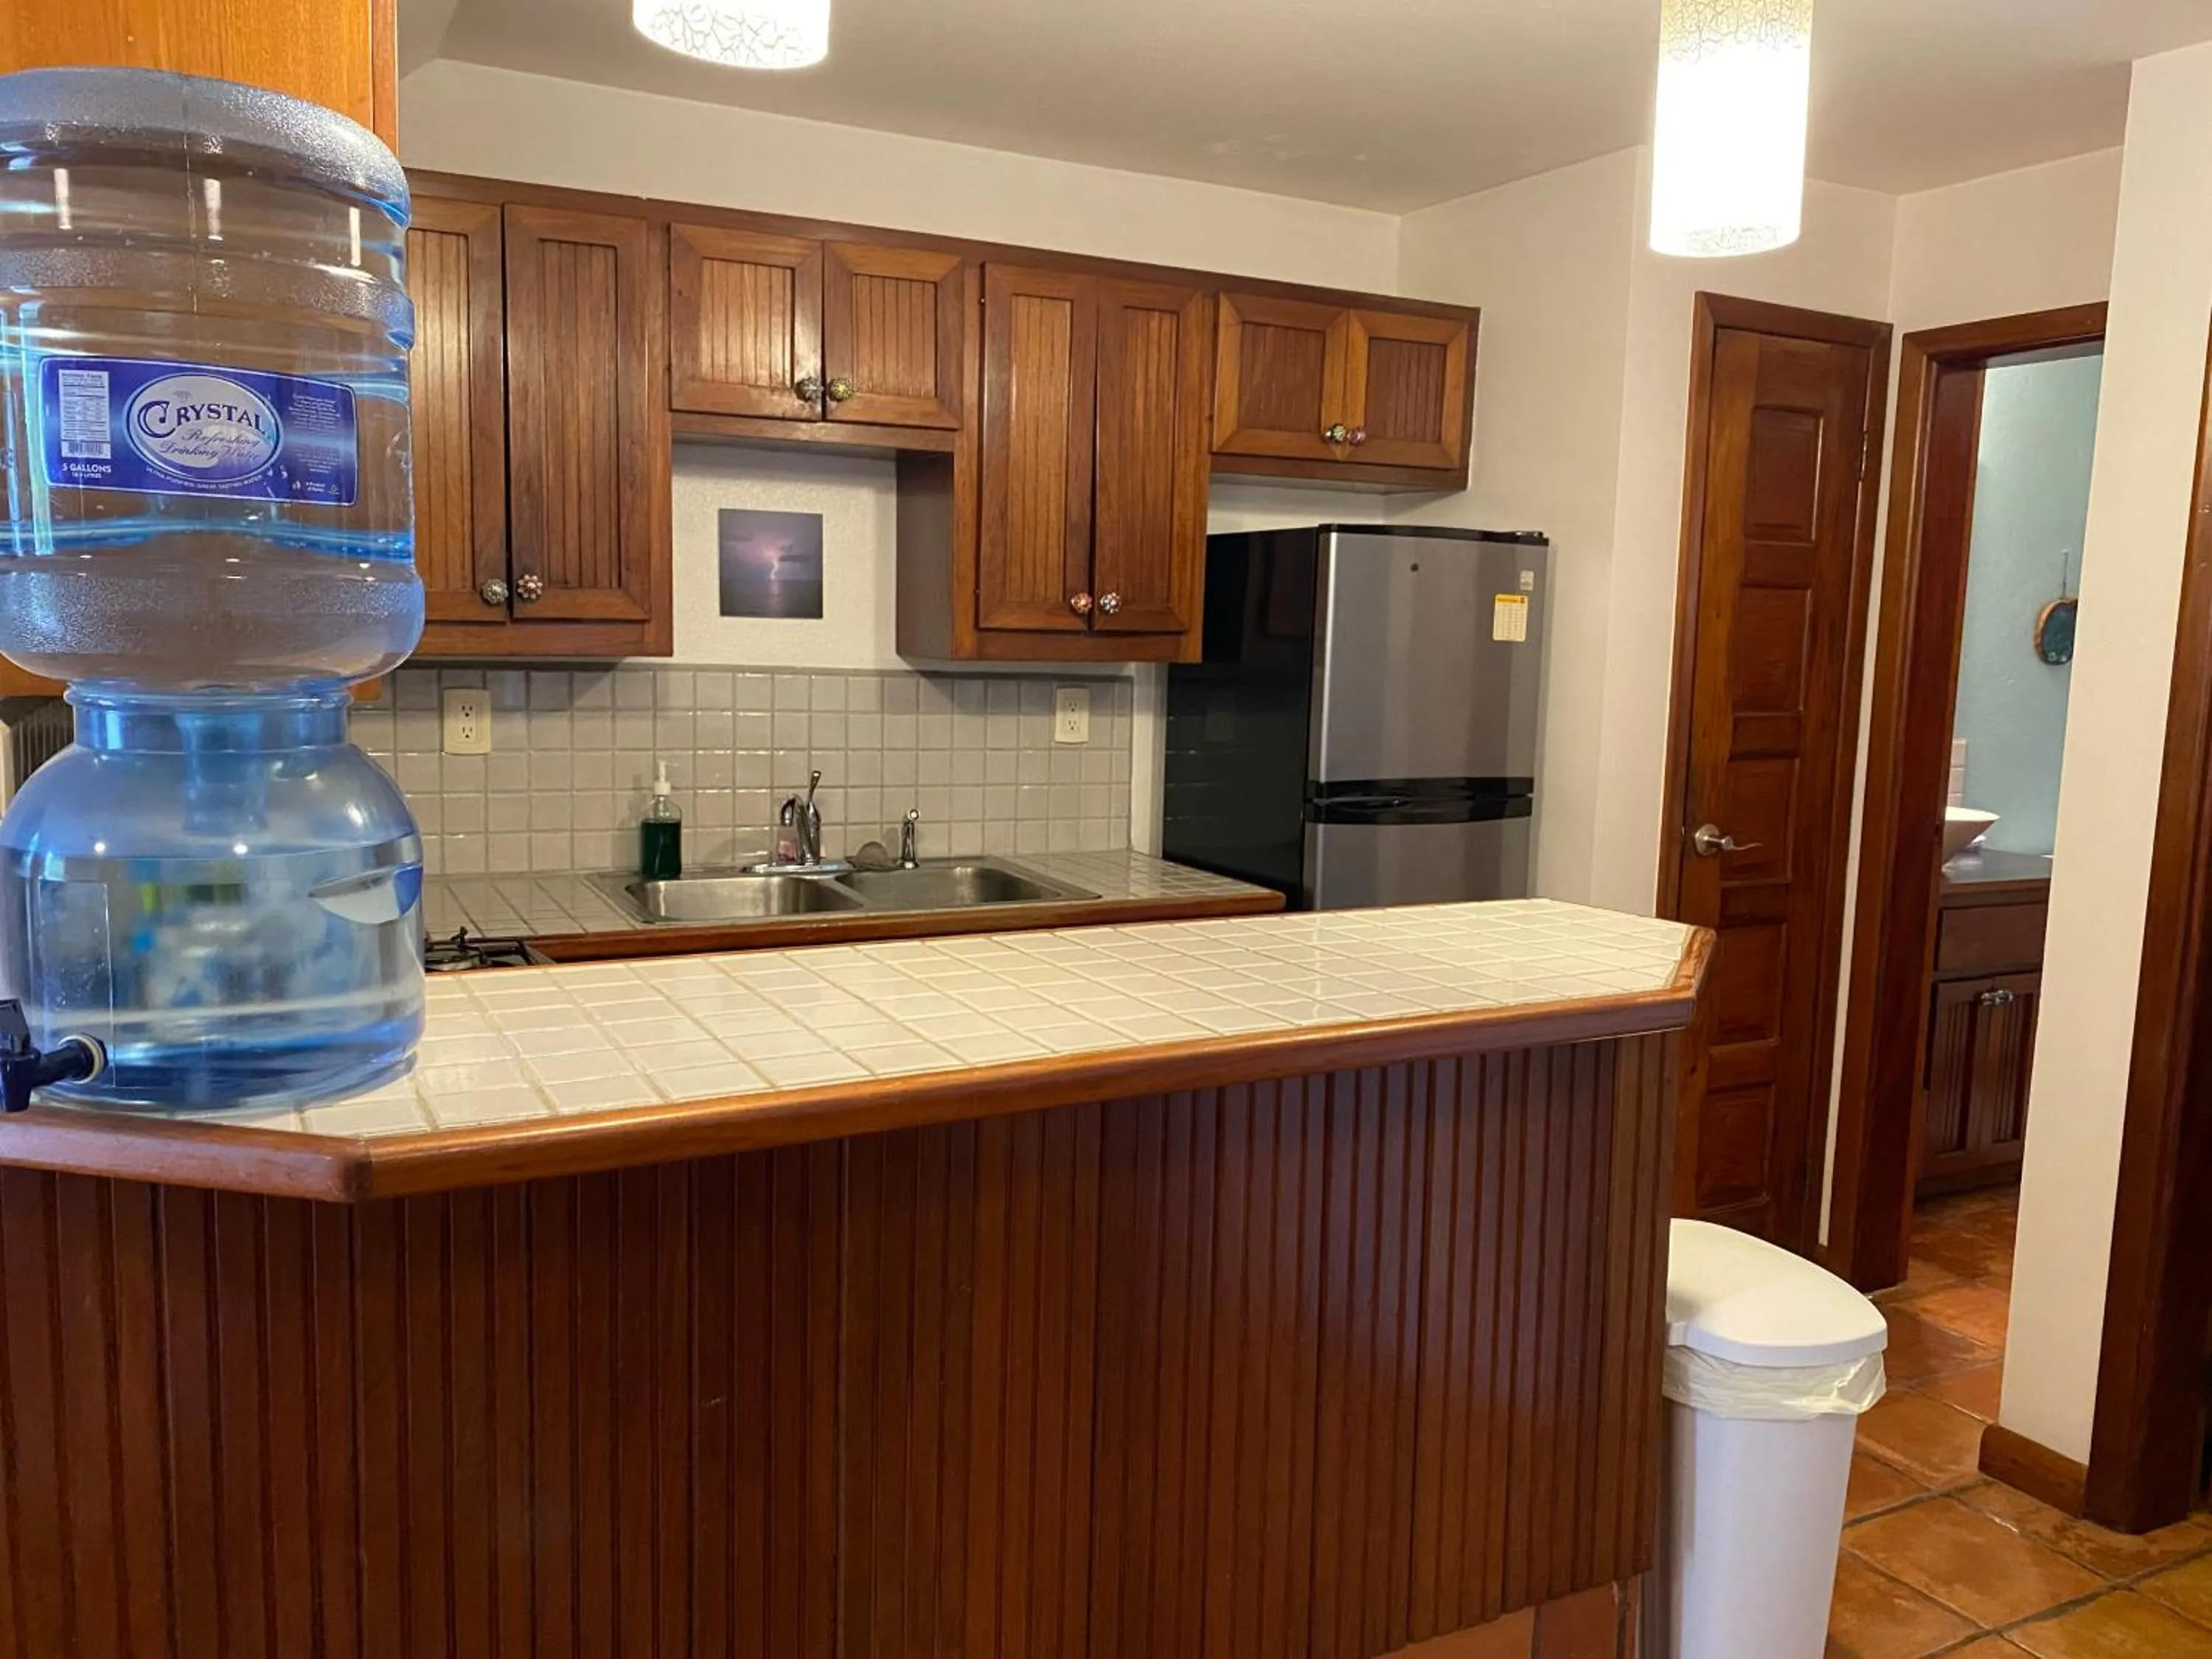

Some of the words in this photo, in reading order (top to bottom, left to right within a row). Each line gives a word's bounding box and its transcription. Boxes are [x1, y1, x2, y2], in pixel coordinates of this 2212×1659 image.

[137, 400, 265, 438] CRYSTAL
[181, 428, 260, 447] Refreshing
[159, 441, 219, 460] Drinking
[70, 462, 111, 473] GALLONS
